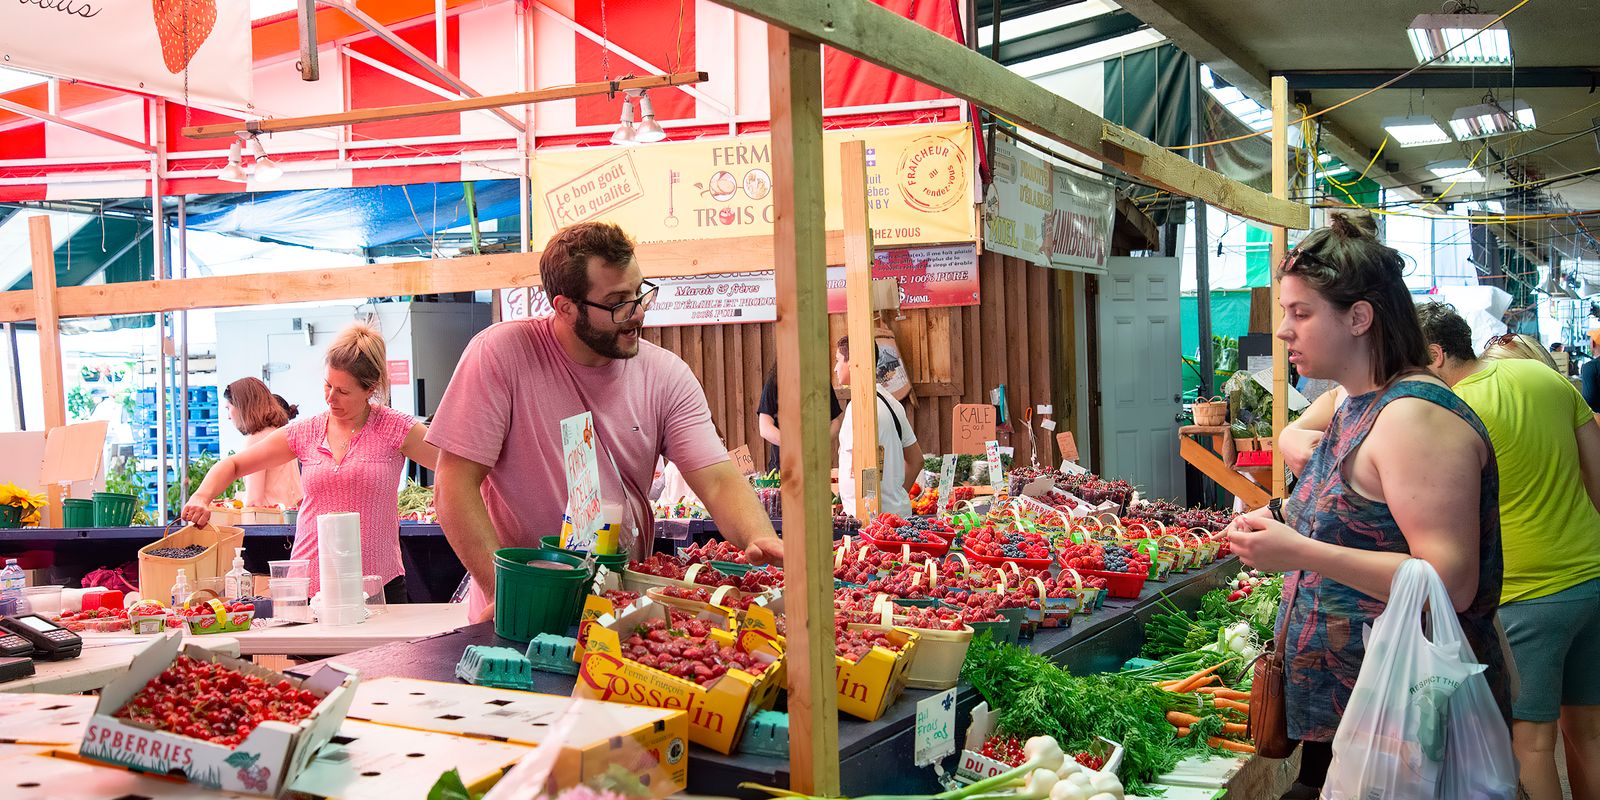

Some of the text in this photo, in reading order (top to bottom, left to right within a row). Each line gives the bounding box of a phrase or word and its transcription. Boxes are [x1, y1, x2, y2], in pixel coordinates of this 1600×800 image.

[922, 164, 956, 197] rendez-vous
[928, 168, 939, 179] au
[556, 163, 626, 206] Le bon goût
[573, 203, 587, 217] la
[589, 178, 631, 212] qualité
[895, 227, 921, 238] VOUS
[910, 272, 935, 284] 100%
[936, 270, 969, 282] PURE
[675, 283, 760, 297] Marois & frères
[959, 407, 991, 424] KALE
[580, 652, 724, 734] Gosselin
[83, 725, 193, 766] SPBERRIES
[965, 758, 984, 774] DU
